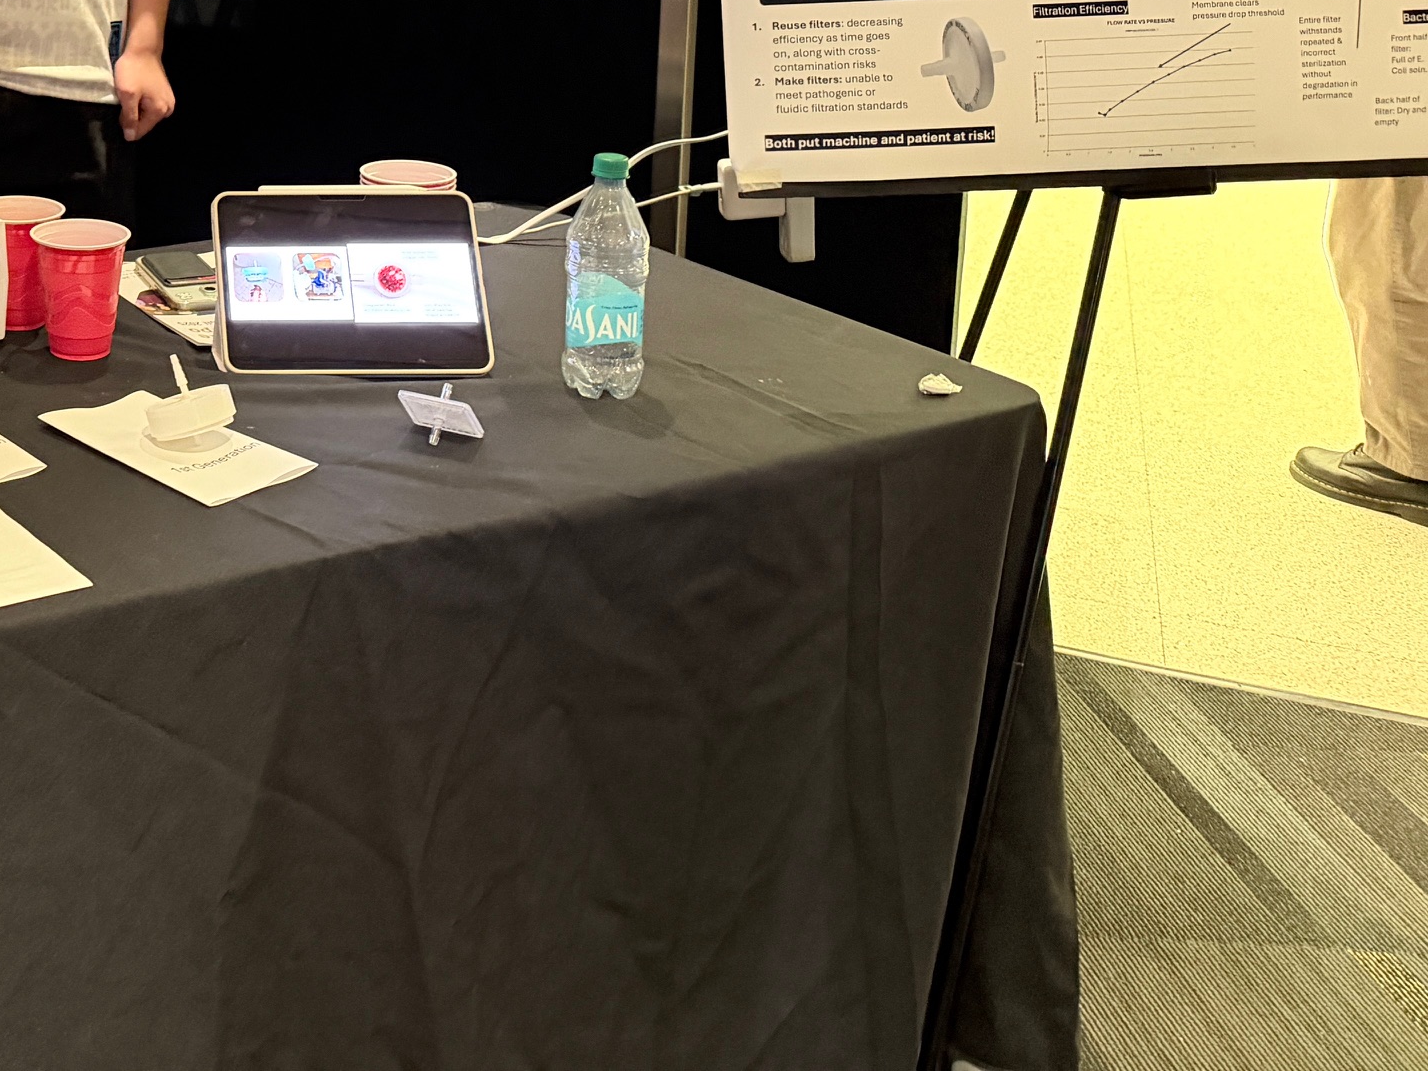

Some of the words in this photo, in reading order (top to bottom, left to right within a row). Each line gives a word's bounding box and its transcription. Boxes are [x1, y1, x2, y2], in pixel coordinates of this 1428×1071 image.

[1033, 5, 1078, 17] Filtration
[1079, 3, 1129, 16] Efficiency
[1191, 0, 1234, 9] Membrane
[1234, 0, 1260, 7] clears
[775, 103, 809, 114] fluidic
[811, 102, 855, 113] filtration
[856, 100, 909, 112] standards
[765, 137, 797, 149] Both
[798, 137, 822, 149] put
[822, 135, 878, 147] machine
[880, 133, 905, 145] and
[906, 132, 951, 146] patient
[953, 131, 966, 142] at
[968, 129, 995, 141] risk!
[192, 442, 261, 470] Generation
